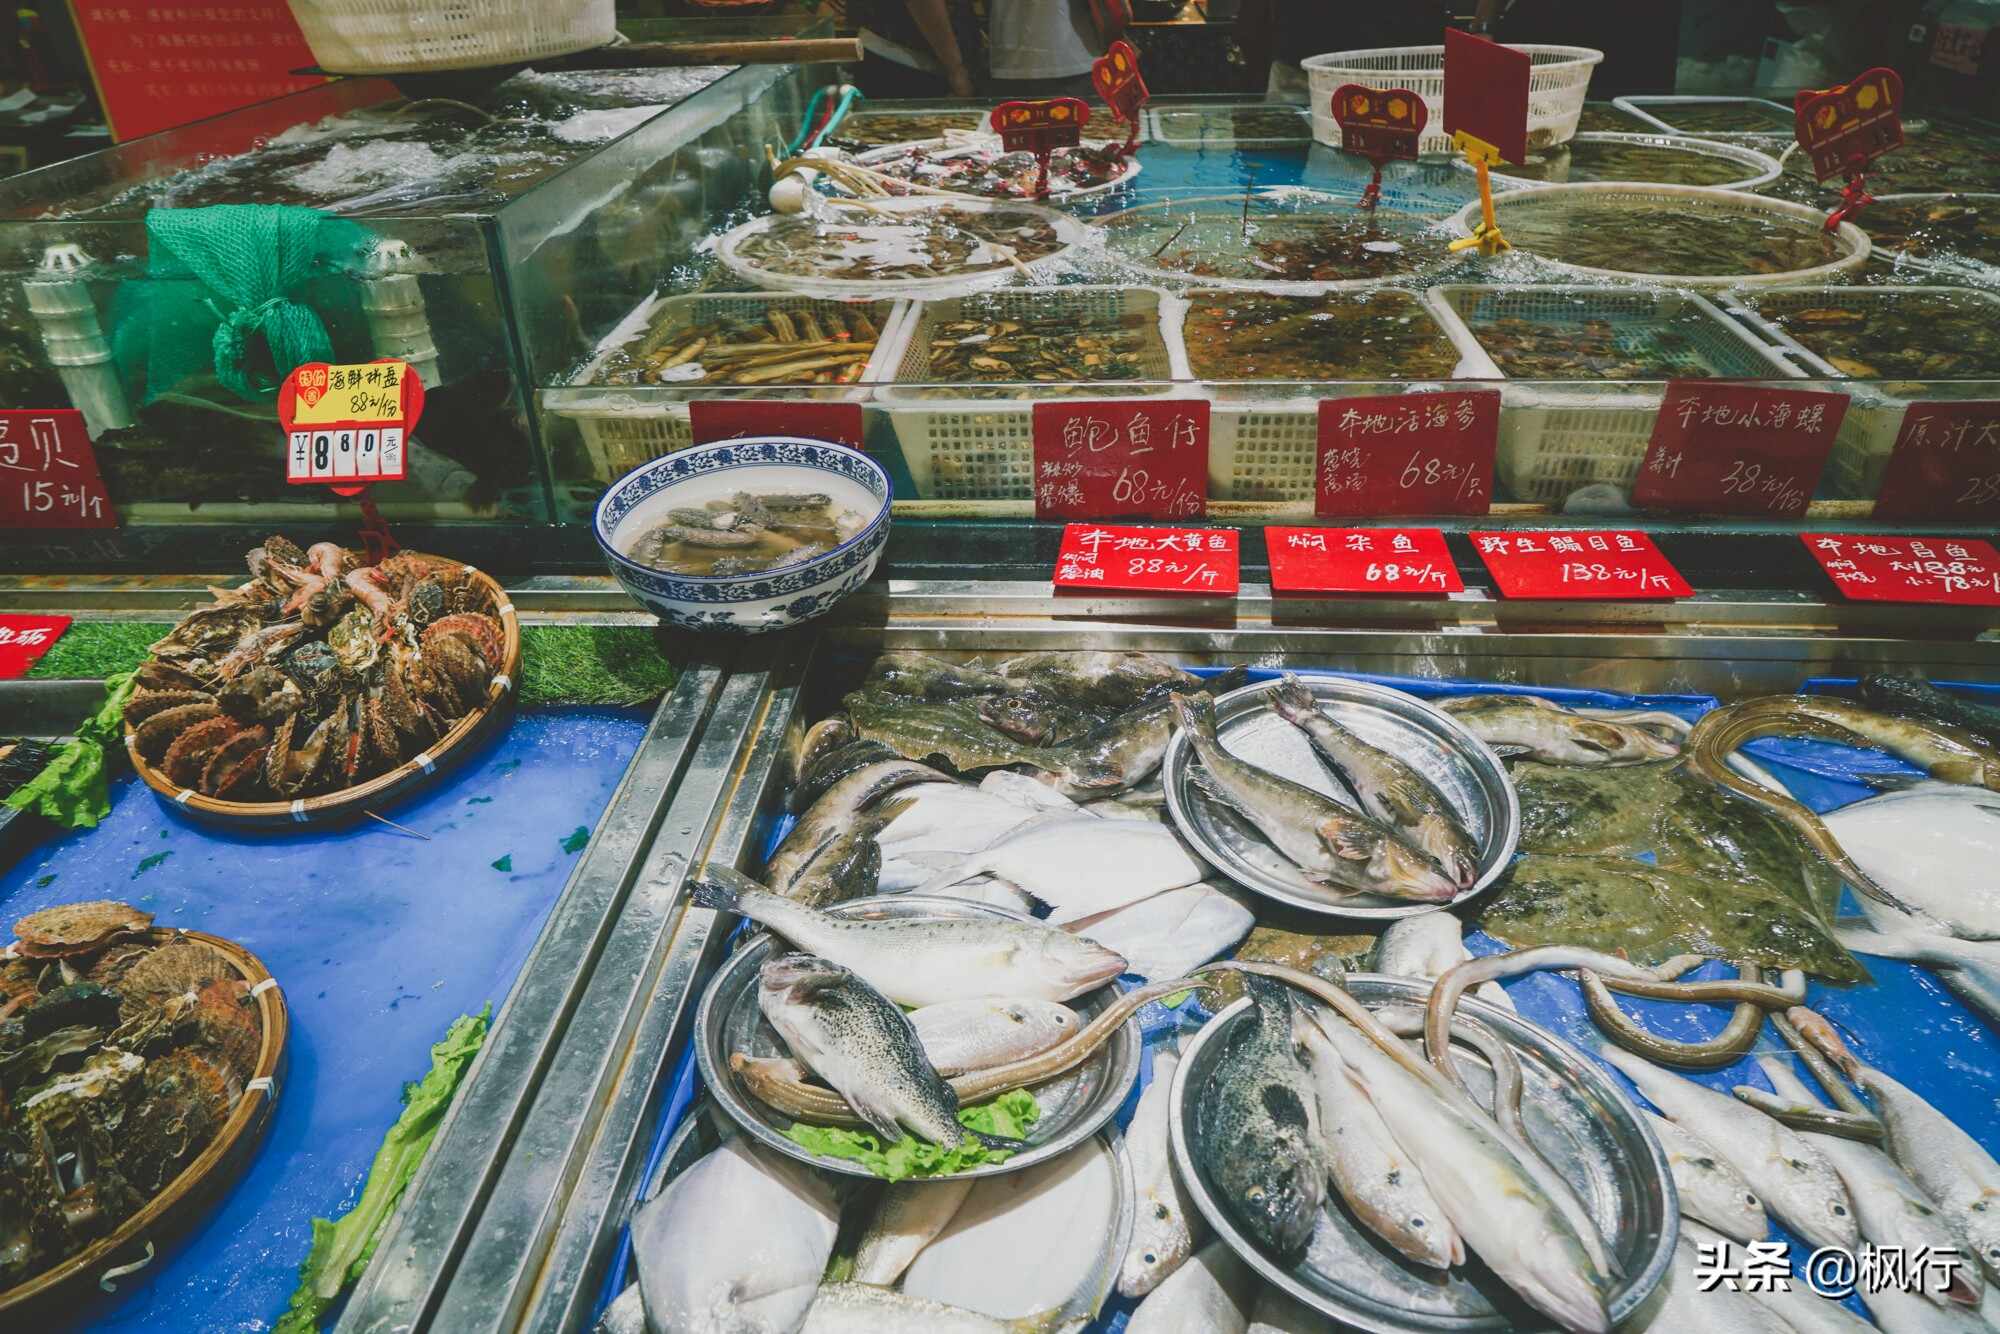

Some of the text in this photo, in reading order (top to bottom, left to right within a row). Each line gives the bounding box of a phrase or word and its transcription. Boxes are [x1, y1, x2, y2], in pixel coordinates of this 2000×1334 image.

[299, 369, 326, 387] 特价
[350, 392, 397, 417] 88元/份
[1338, 399, 1476, 438] 本地活海参
[1676, 396, 1826, 433] 本地小海螺
[1064, 412, 1200, 458] 鲍鱼仔
[1112, 467, 1200, 515] 68元/份
[1400, 450, 1484, 500] 68元/只
[1721, 460, 1804, 510] 38元/份
[23, 481, 104, 518] 15元/个
[1079, 529, 1232, 552] 本地大黄鱼
[1816, 537, 1978, 560] 本地昌鱼
[1128, 558, 1220, 586] 88元/斤
[1365, 563, 1447, 588] 68元/斤
[1562, 563, 1672, 591] 138元/斤
